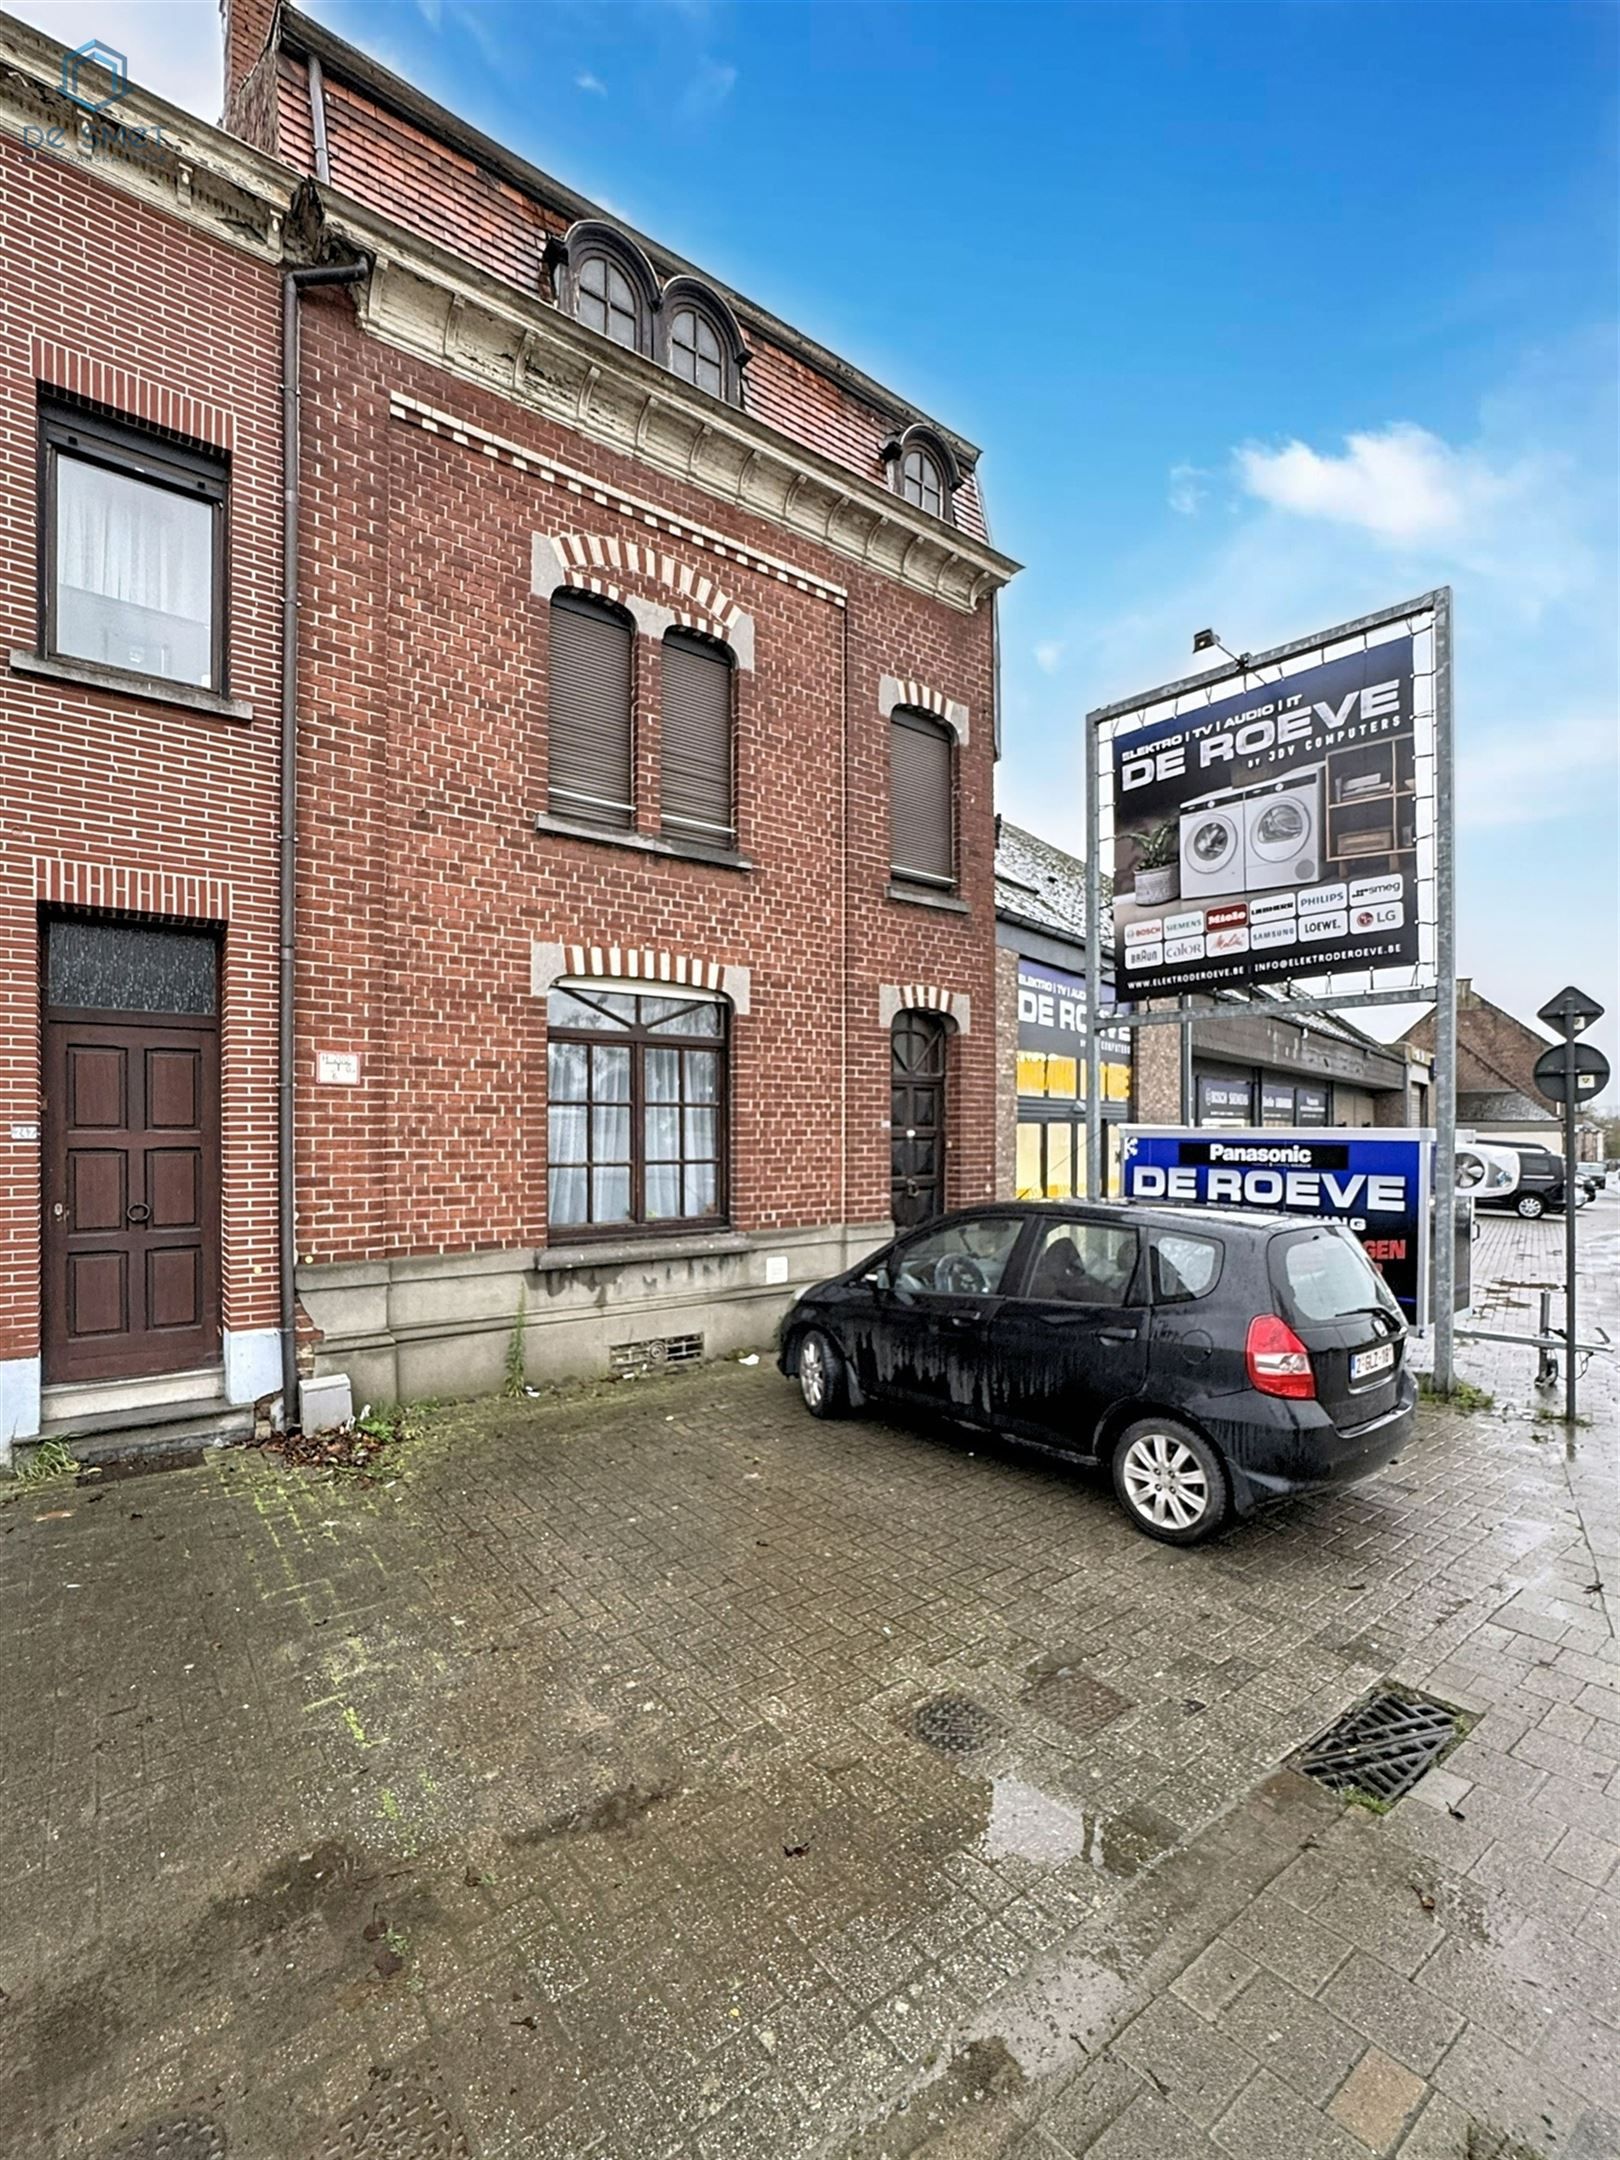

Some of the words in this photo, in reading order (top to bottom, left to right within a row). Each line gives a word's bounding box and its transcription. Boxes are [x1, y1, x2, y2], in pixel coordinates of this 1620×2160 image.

[1121, 735, 1183, 761] ELEKTRO
[1192, 724, 1213, 738] TV
[1223, 703, 1275, 729] AUDIO
[1286, 694, 1303, 708] IT
[1121, 747, 1186, 792] DE
[1199, 679, 1400, 768] ROEVE
[1268, 745, 1296, 762] JDV
[1305, 715, 1401, 751] COMPUTERS
[1368, 881, 1401, 895] smeg
[1300, 892, 1345, 907] PHILIPS
[1166, 919, 1202, 932] SIEMENS
[1376, 910, 1397, 923] LG
[1135, 926, 1161, 937] BOSCH
[1252, 926, 1295, 941] SAMSUNG
[1127, 966, 1244, 989] WWW.ELEKTRODEROEVE.BE
[1254, 943, 1402, 973] INFO@ELEKTRODEROEVE.BE
[1018, 989, 1055, 1027] DE
[1209, 1144, 1312, 1164] Panasonic
[1132, 1166, 1198, 1200] DE
[1206, 1169, 1406, 1212] ROEVE
